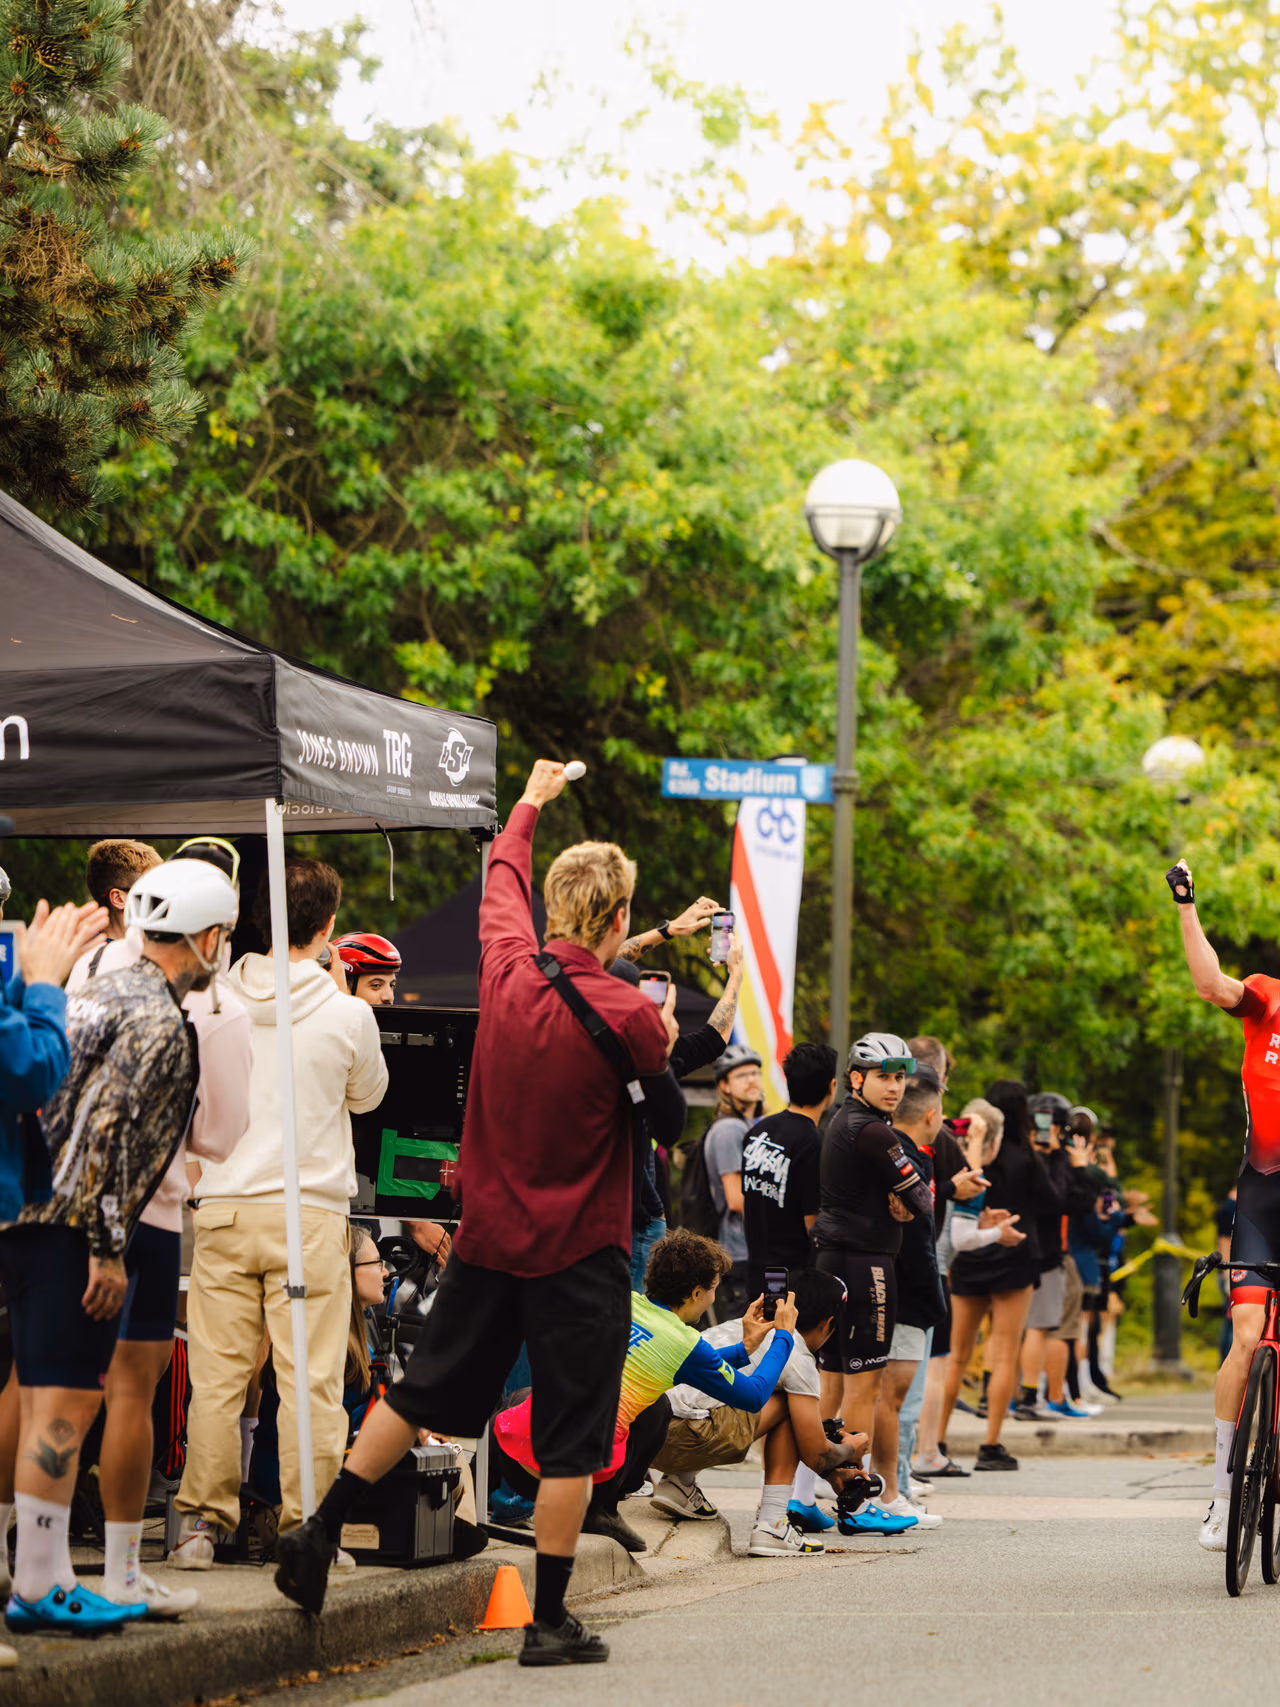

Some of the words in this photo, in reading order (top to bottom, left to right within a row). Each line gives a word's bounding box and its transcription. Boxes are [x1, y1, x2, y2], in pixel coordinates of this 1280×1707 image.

[296, 729, 337, 770] JONES
[337, 740, 379, 776] BROWN
[383, 729, 413, 777] TRG
[704, 765, 797, 795] Stadium
